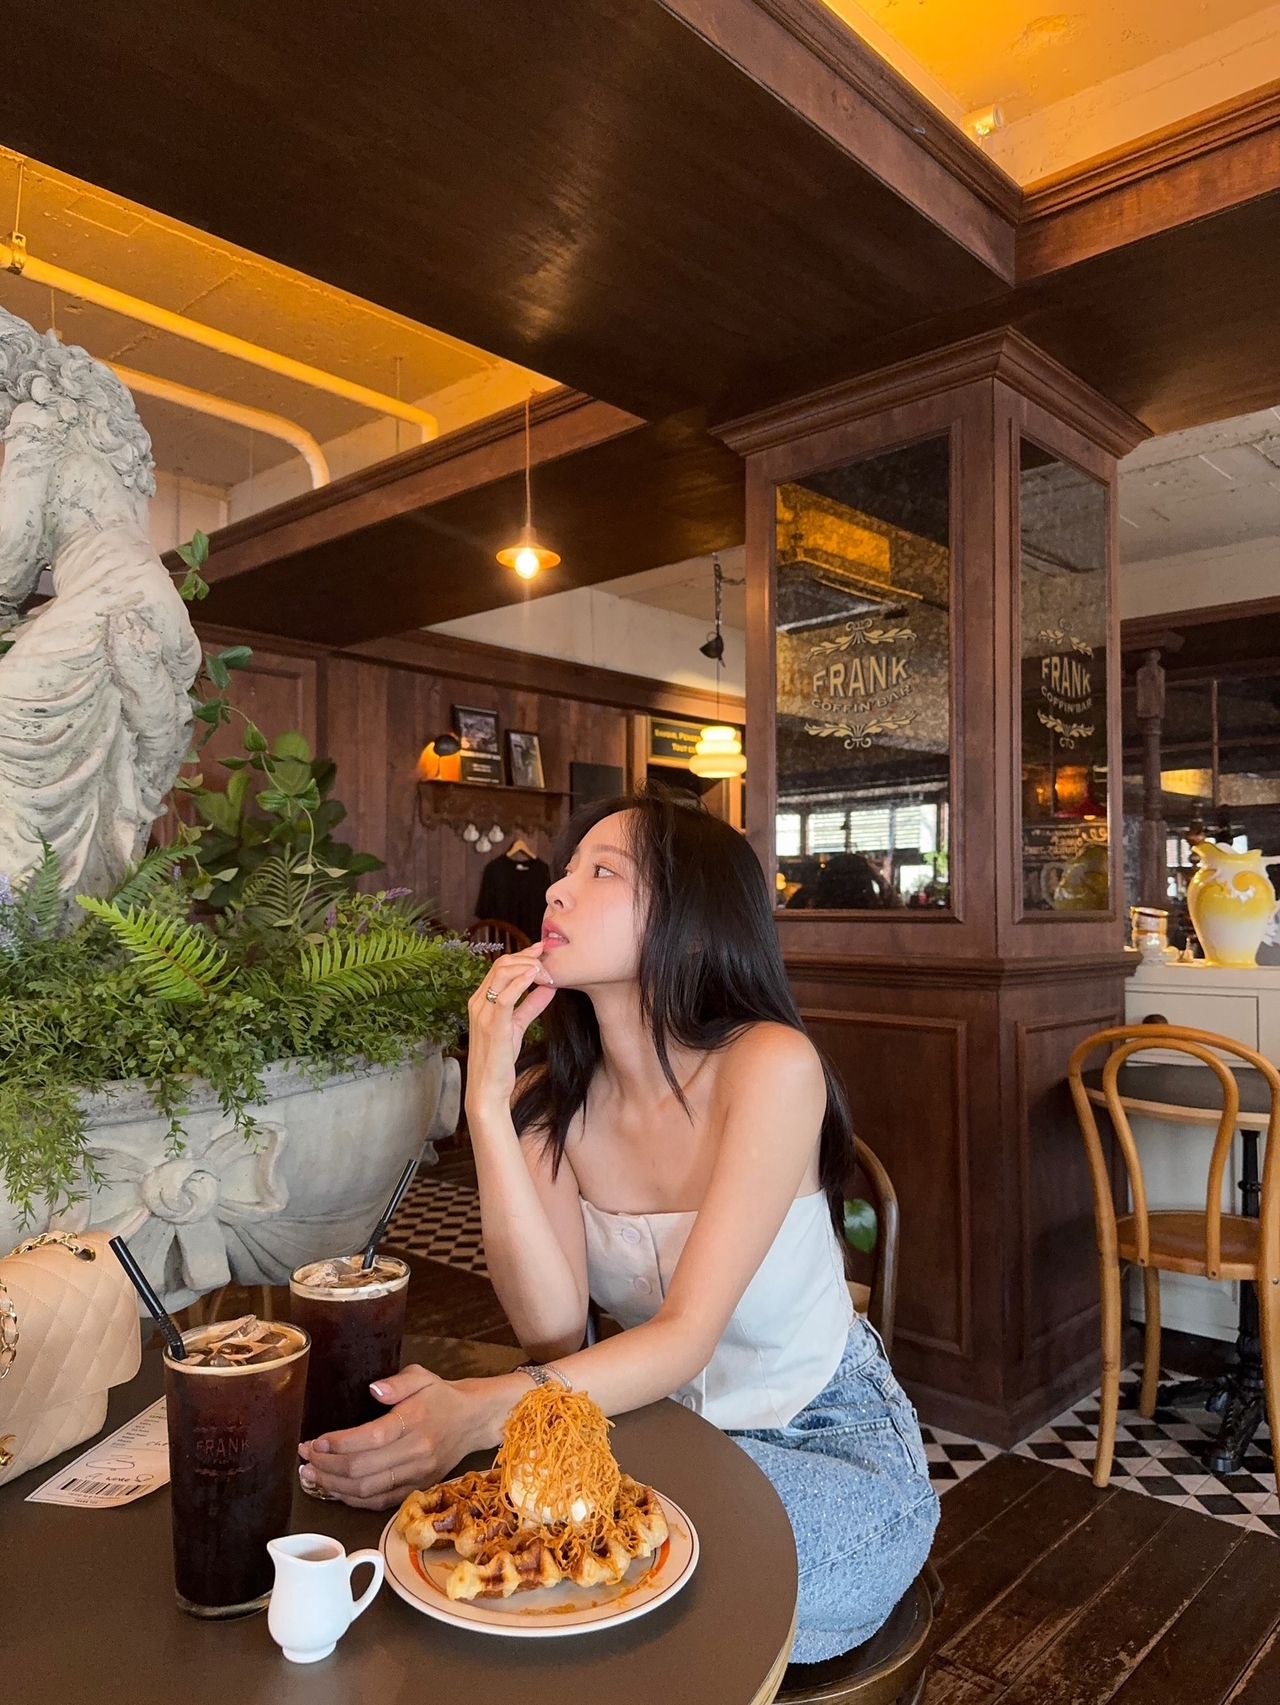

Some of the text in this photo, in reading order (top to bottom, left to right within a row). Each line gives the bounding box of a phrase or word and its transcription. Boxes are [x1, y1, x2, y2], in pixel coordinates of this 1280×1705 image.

[812, 656, 910, 698] FRANK
[1041, 656, 1091, 698] FRANK
[196, 1438, 250, 1457] FRANK
